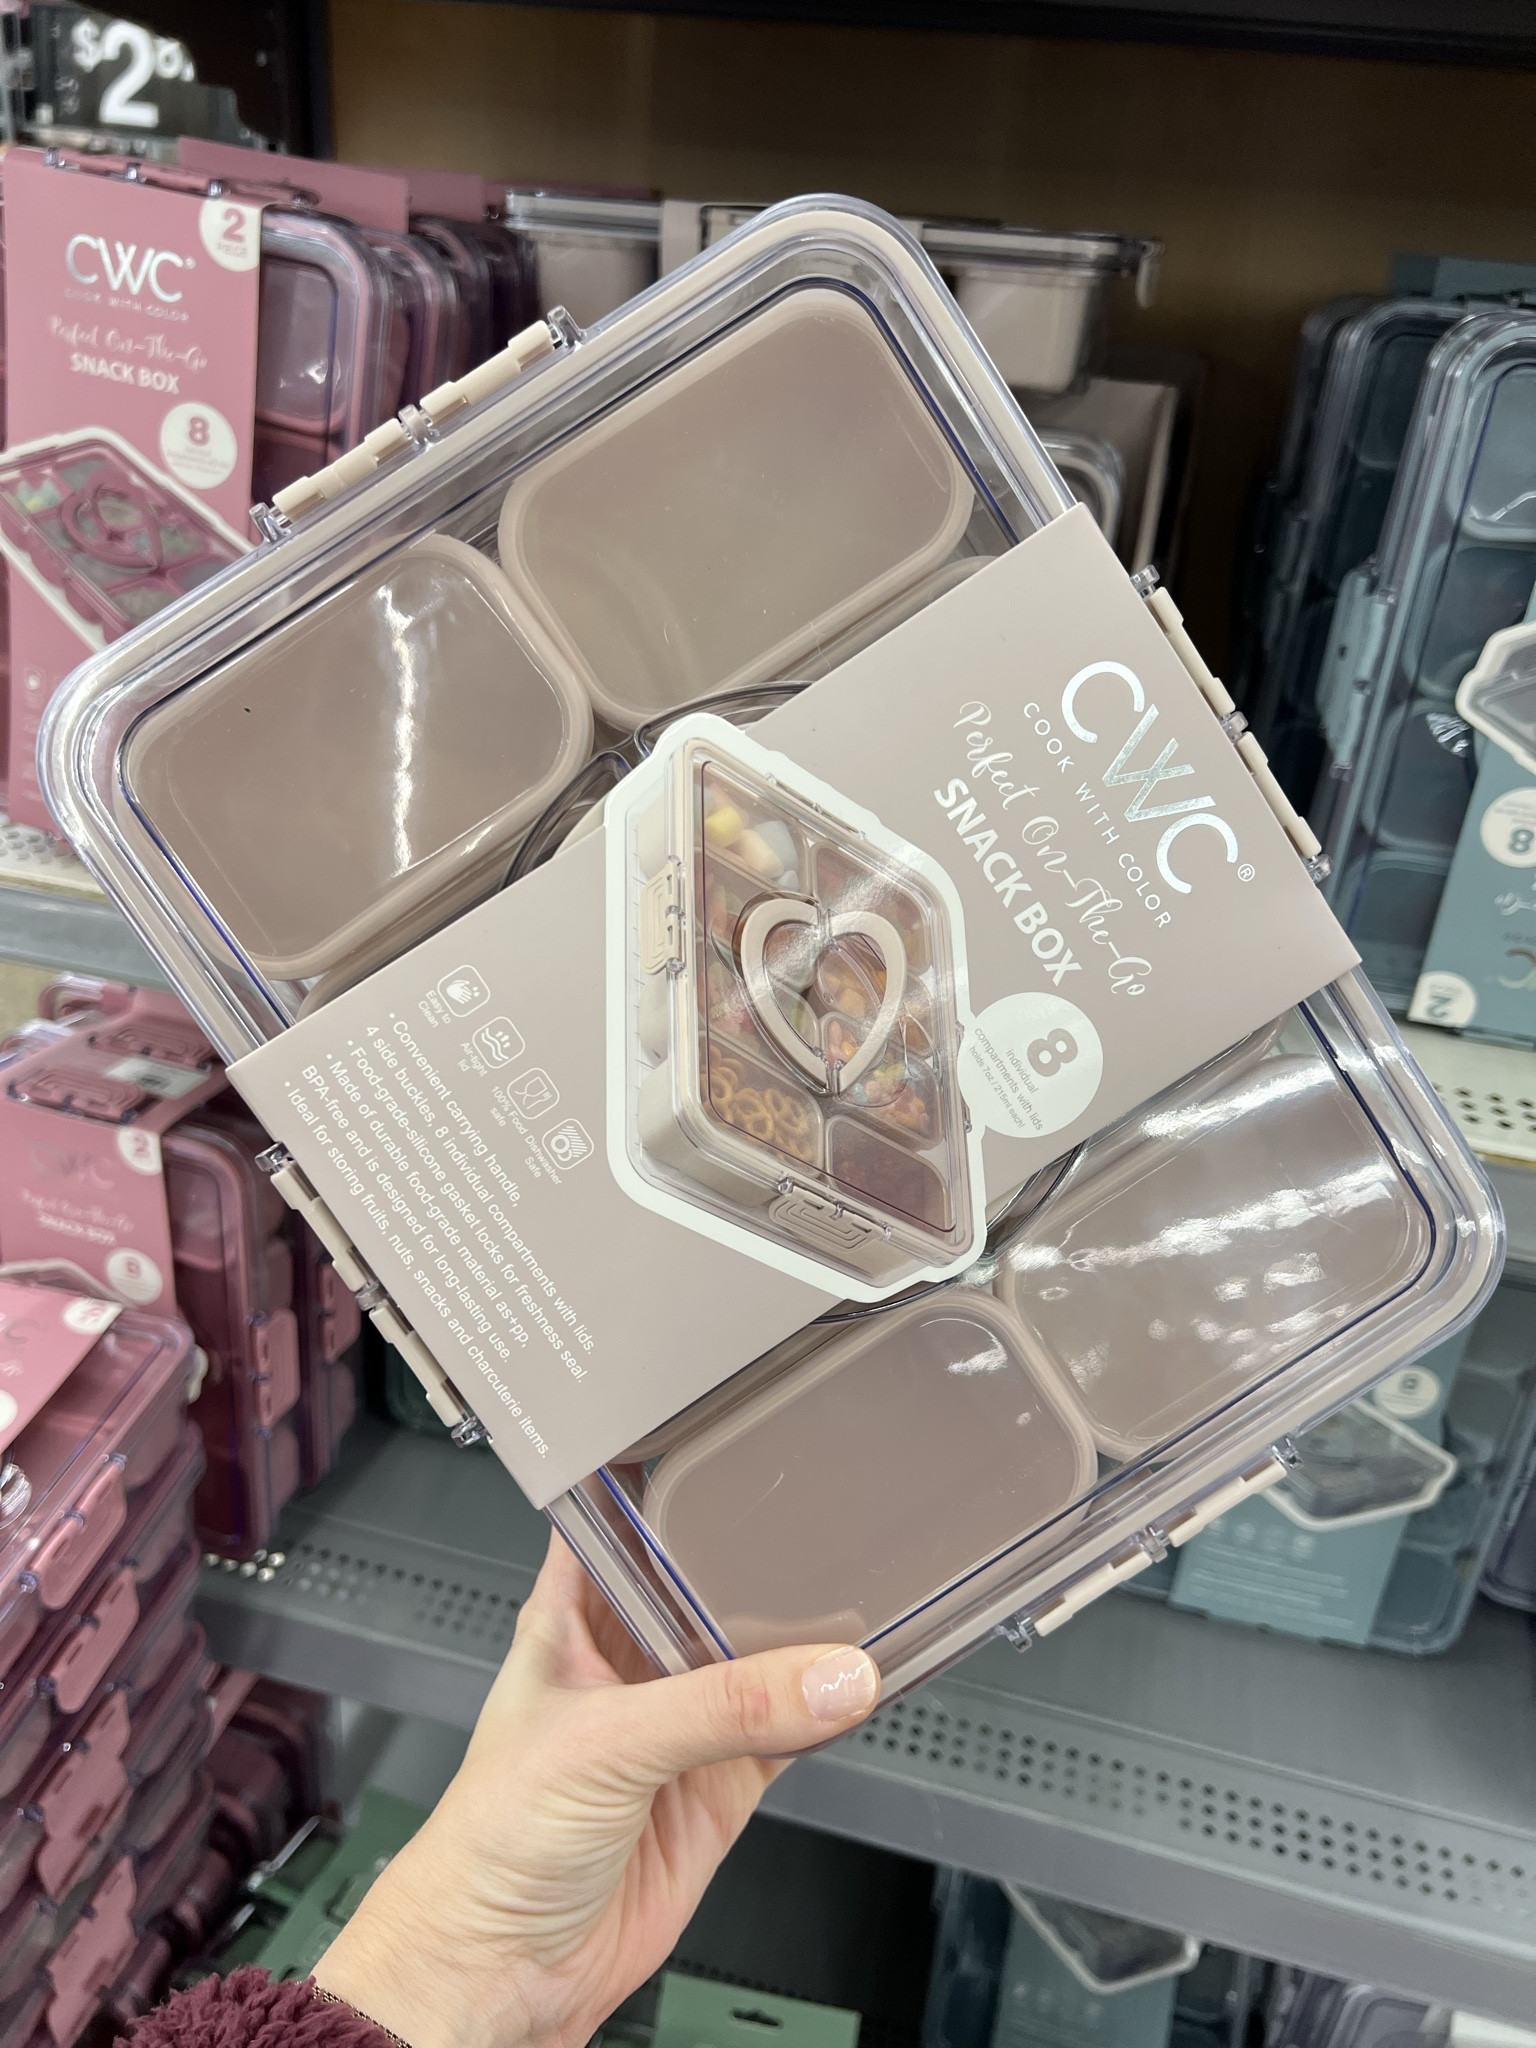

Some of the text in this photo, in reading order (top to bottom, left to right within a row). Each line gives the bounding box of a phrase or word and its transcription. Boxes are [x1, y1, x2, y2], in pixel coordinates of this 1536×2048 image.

[223, 207, 246, 243] 2
[70, 351, 180, 395] SNACK BOX
[189, 415, 210, 446] 8
[953, 701, 1040, 810] Perfect
[1023, 702, 1171, 928] COOK WITH COLOR
[933, 778, 1083, 987] SNACK BOX
[418, 1000, 439, 1028] Clean
[425, 989, 451, 1024] Easy to
[457, 1058, 471, 1072] lid
[460, 1042, 488, 1077] Air-tight
[968, 1044, 985, 1068] holds
[982, 1065, 995, 1082] 7oz
[1004, 1048, 1039, 1094] individual
[1026, 1027, 1079, 1077] 8
[974, 1027, 1043, 1131] compartments with lids
[392, 1020, 520, 1207] Convenient carrying handle,
[490, 1107, 506, 1127] safe
[491, 1086, 528, 1135] 100% Food
[524, 1134, 562, 1184] Dishwasher
[524, 1156, 541, 1178] Safe
[301, 1064, 510, 1363] BPA-free and is designed for long-lasting use.
[328, 1060, 529, 1348] Made of durable food-grade material as+pp,
[349, 1046, 588, 1383] Food-grade-silicone gasket locks for freshness seal.
[366, 1026, 594, 1354] 4 side buckles, 8 individual compartments with lids.
[287, 1088, 549, 1458] Ideal for storing fruits, nuts, snacks and charcuterie items.
